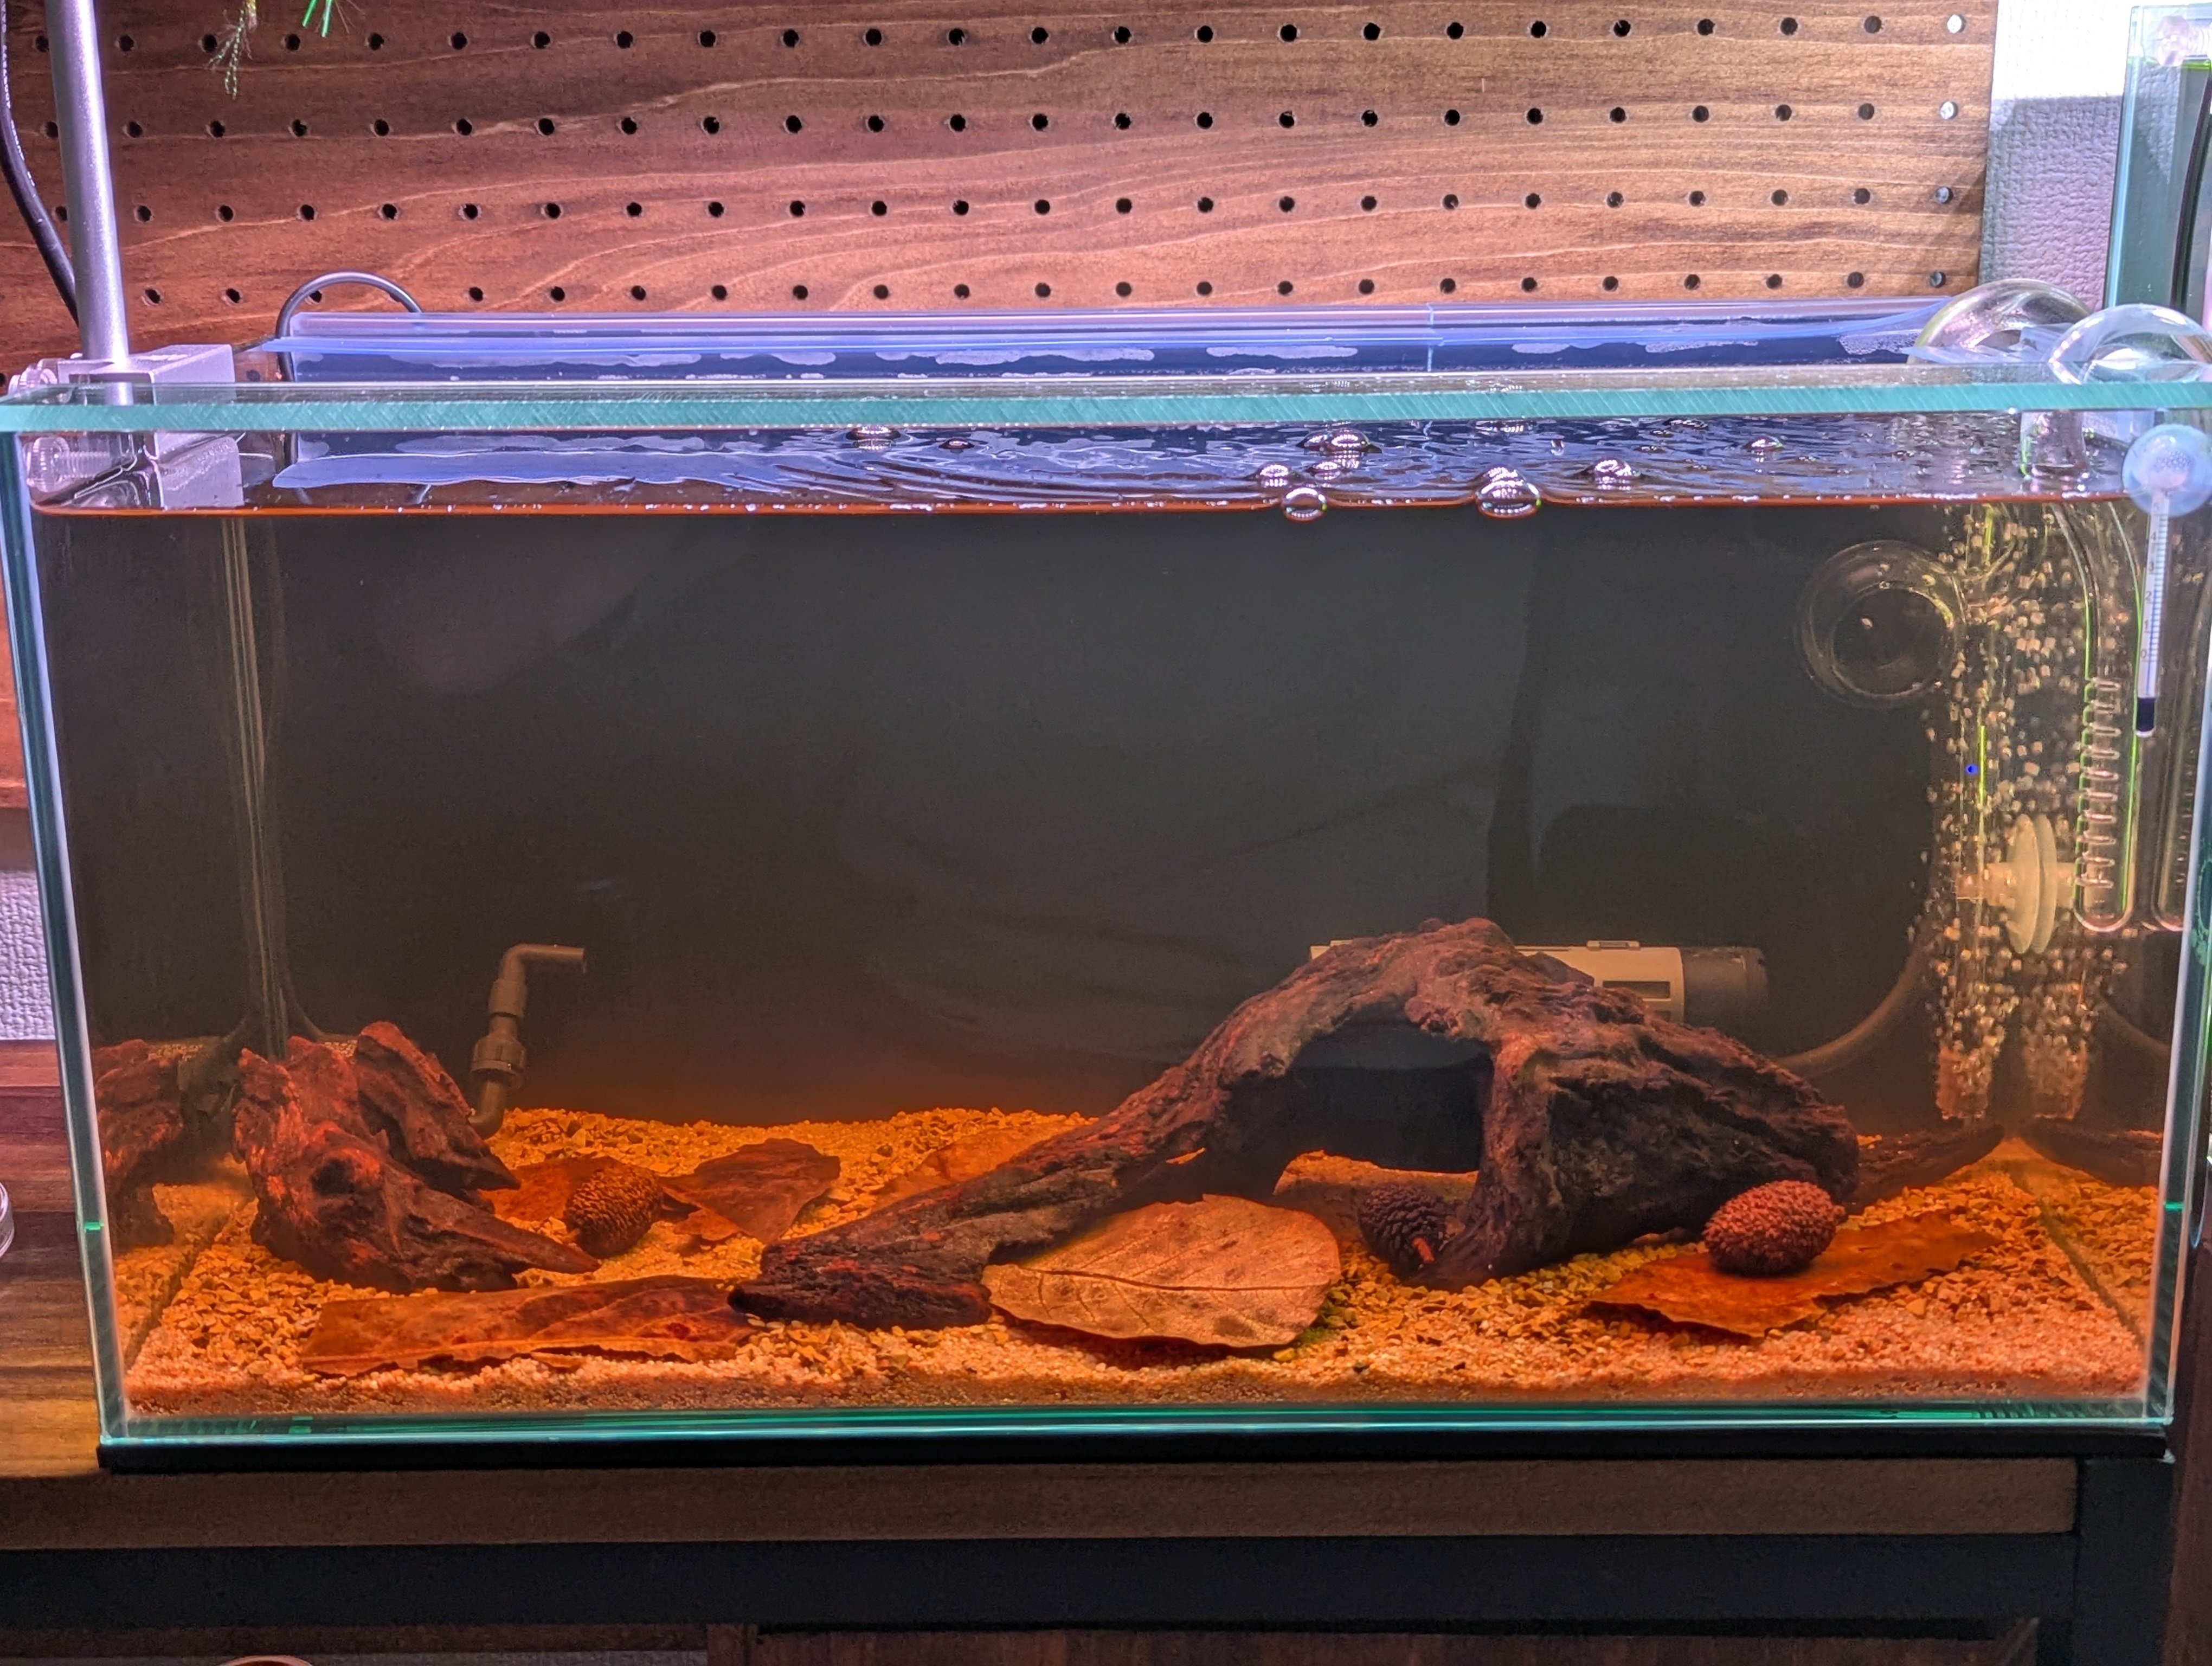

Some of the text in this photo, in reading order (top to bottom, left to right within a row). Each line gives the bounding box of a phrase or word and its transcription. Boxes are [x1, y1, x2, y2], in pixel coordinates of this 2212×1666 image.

[2150, 531, 2156, 541] 4
[2149, 561, 2154, 572] 3
[2145, 591, 2151, 600] 2
[2144, 620, 2149, 628] 1
[2140, 649, 2147, 658] 0
